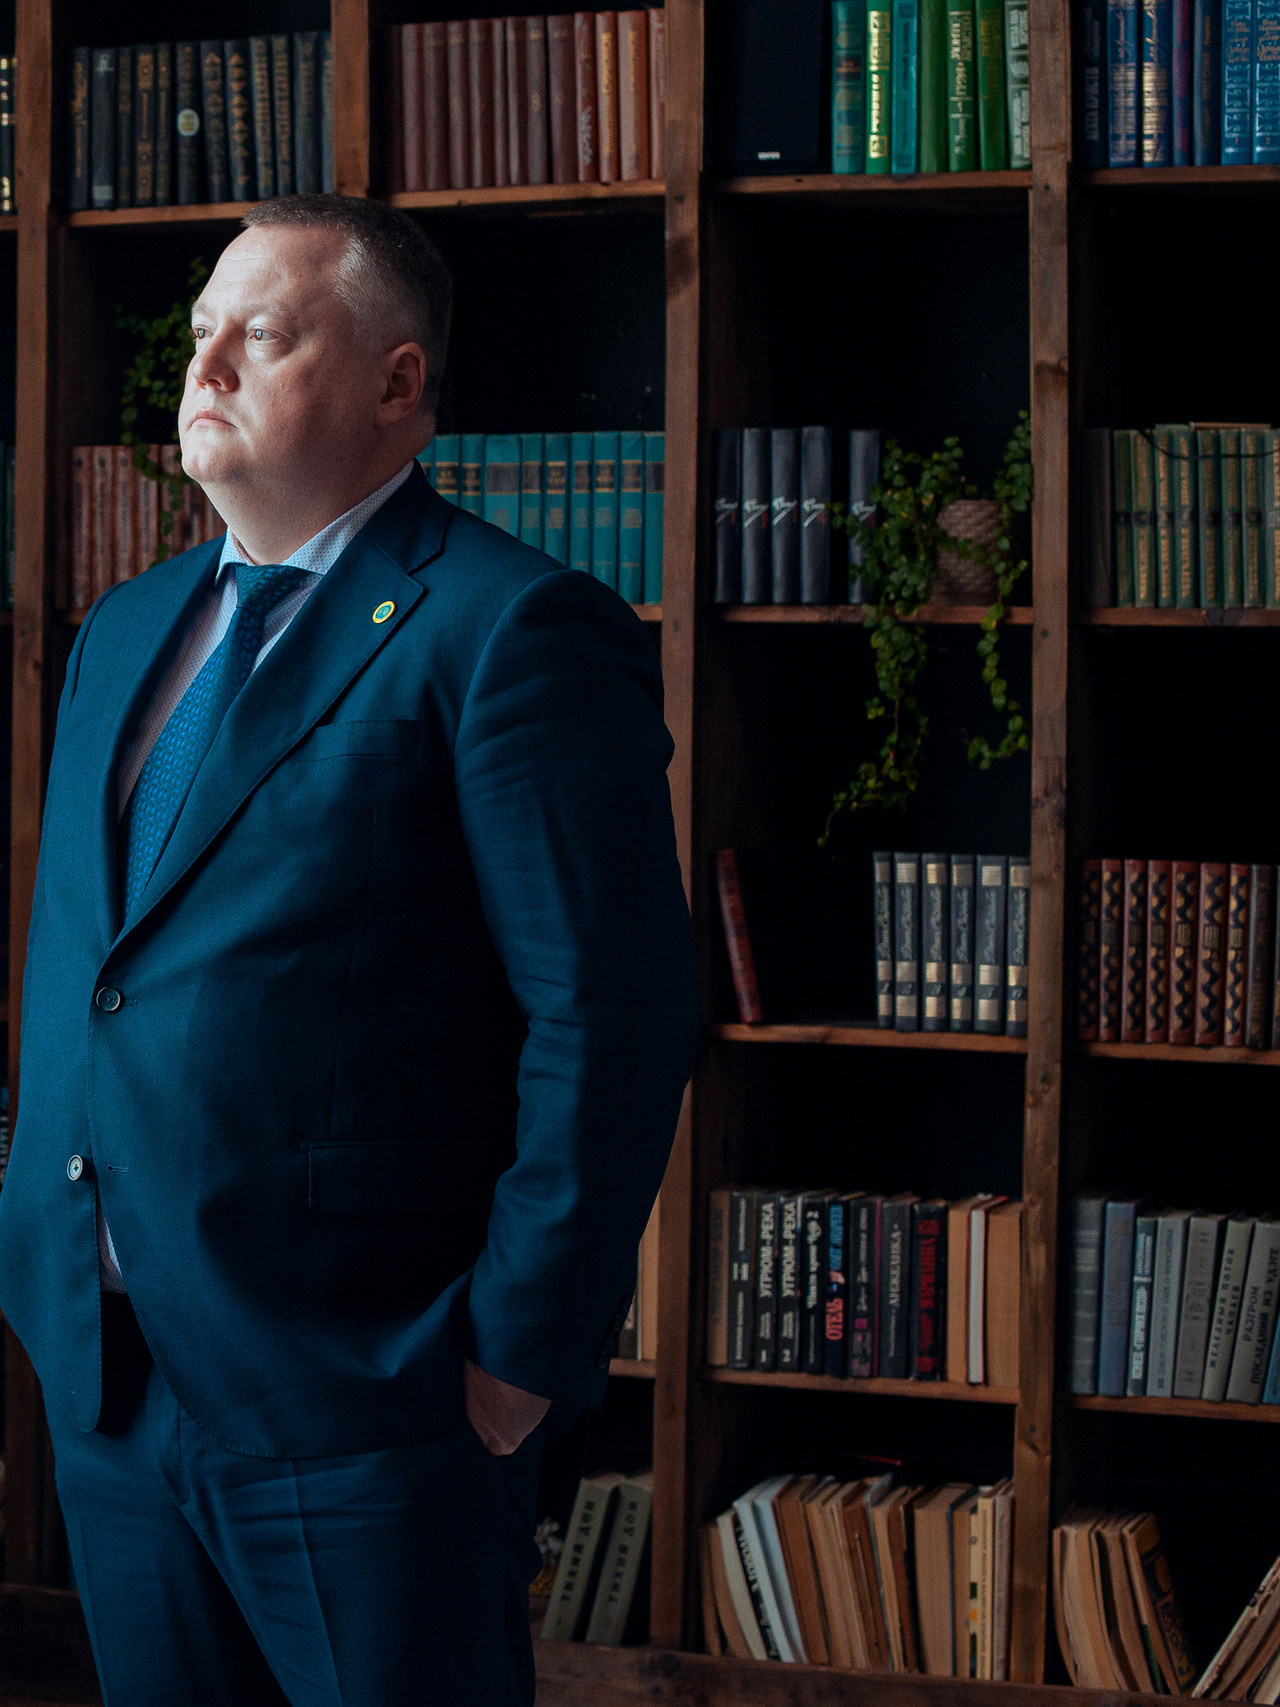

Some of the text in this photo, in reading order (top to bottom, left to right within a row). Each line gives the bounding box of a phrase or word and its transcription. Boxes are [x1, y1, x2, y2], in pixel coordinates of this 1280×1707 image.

[759, 1202, 774, 1298] УГРЮМ-РЕКА
[781, 1202, 796, 1298] УГРЮМ-РЕКА
[825, 1298, 844, 1341] ОТЕЛЬ
[1210, 1249, 1235, 1369] ЖЕЛЕЗНЫЙ ПОТОК
[1226, 1285, 1241, 1335] ЧАПАЕВ
[1243, 1286, 1259, 1342] РАЗГРОМ
[1250, 1248, 1278, 1385] ПОСЛЕДНИЙ ИЗ УДЭГЕ
[760, 1349, 767, 1363] 1
[783, 1348, 791, 1363] 2
